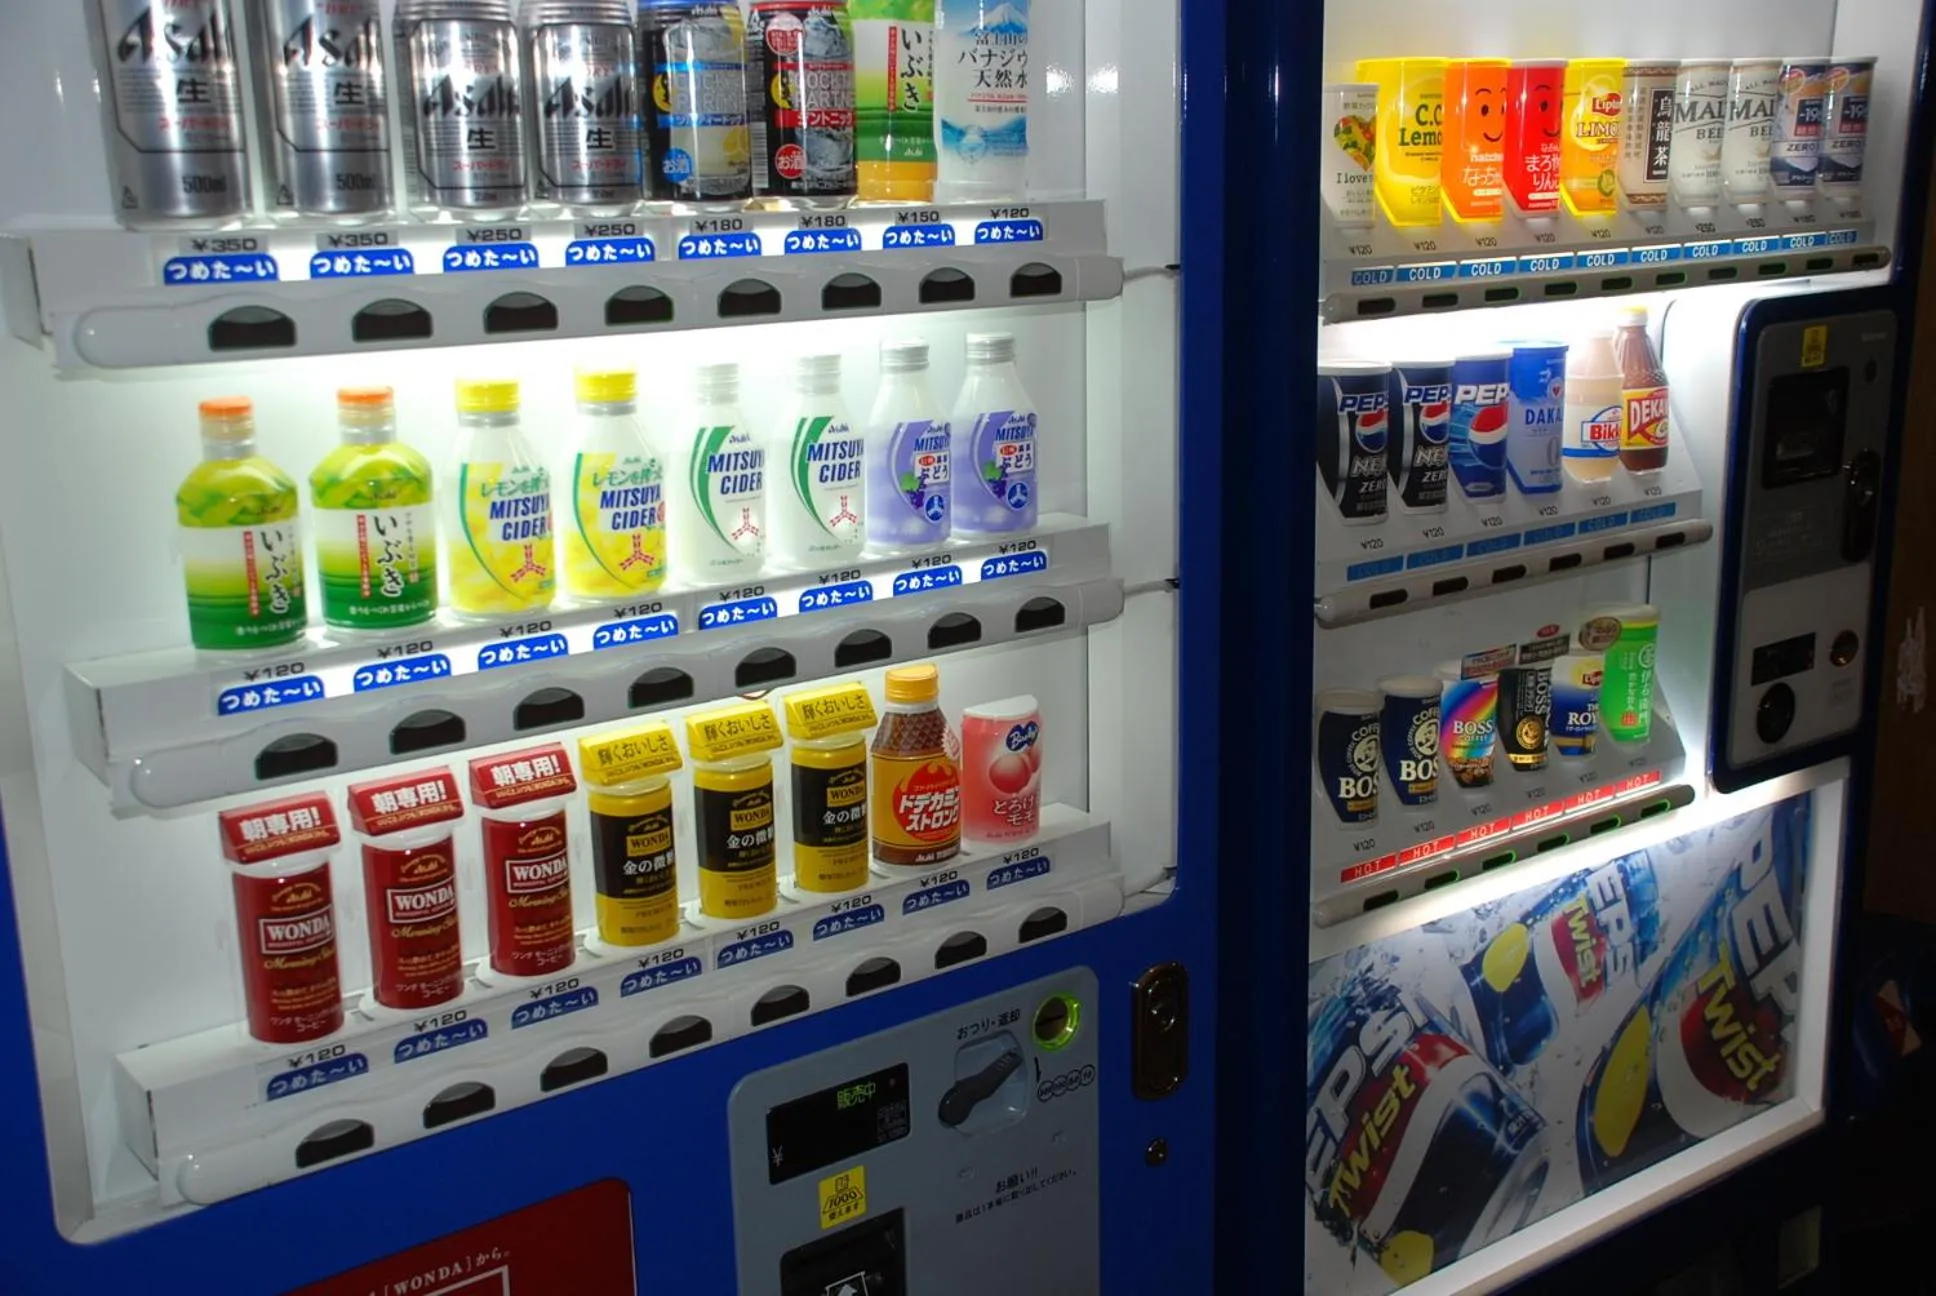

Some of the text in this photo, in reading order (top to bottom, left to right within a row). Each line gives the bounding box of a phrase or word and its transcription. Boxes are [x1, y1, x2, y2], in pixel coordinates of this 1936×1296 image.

[901, 28, 923, 112] いぶき
[974, 69, 1028, 89] 天然水
[177, 79, 211, 104] 生
[335, 82, 366, 105] 生
[467, 128, 498, 150] 生
[586, 128, 614, 149] 生
[802, 214, 846, 228] ¥180
[899, 211, 940, 224] ¥150
[990, 207, 1030, 219] ¥120
[585, 224, 636, 236] ¥250
[695, 218, 743, 234] ¥180
[328, 233, 388, 247] ¥350
[466, 228, 523, 243] ¥250
[1475, 237, 1498, 248] ¥120
[1789, 236, 1816, 250] COLD
[191, 237, 257, 253] ¥350
[1414, 241, 1437, 251] ¥120
[1691, 245, 1719, 258] COLD
[1741, 239, 1768, 253] COLD
[1530, 257, 1560, 272] COLD
[1586, 253, 1615, 268] COLD
[1639, 250, 1668, 263] COLD
[1408, 267, 1442, 281] COLD
[1470, 262, 1502, 276] COLD
[819, 460, 861, 484] CIDER
[720, 471, 762, 496] CIDER
[1643, 486, 1662, 497] ¥120
[1592, 496, 1612, 507] ¥120
[611, 506, 657, 530] CIDER
[1538, 505, 1559, 517] ¥120
[502, 517, 547, 541] CIDER
[1481, 516, 1503, 527] ¥120
[1422, 527, 1445, 539] ¥120
[998, 540, 1037, 554] ¥120
[1361, 538, 1384, 550] ¥120
[374, 515, 403, 597] いぶき
[912, 555, 952, 569] ¥120
[260, 529, 289, 614] いぶき
[818, 570, 861, 584] ¥120
[719, 586, 765, 601] ¥120
[614, 603, 663, 618] ¥120
[500, 621, 552, 637] ¥120
[378, 641, 433, 658] ¥120
[245, 662, 305, 681] ¥120
[1453, 720, 1493, 734] BOSS
[1626, 774, 1650, 790] HOT
[1577, 790, 1601, 806] HOT
[1525, 805, 1549, 822] HOT
[1470, 822, 1496, 839] HOT
[1003, 847, 1040, 863] ¥120
[1412, 841, 1440, 859] HOT
[513, 859, 567, 883] WONDA
[1355, 860, 1382, 878] HOT
[920, 871, 959, 888] ¥120
[395, 887, 454, 912] WONDA
[831, 896, 872, 913] ¥120
[266, 917, 332, 942] WONDA
[736, 922, 782, 940] ¥120
[638, 949, 684, 968] ¥120
[530, 978, 580, 998] ¥120
[1698, 928, 1784, 1092] Twist
[414, 1010, 467, 1031] ¥120
[289, 1045, 346, 1068] ¥120
